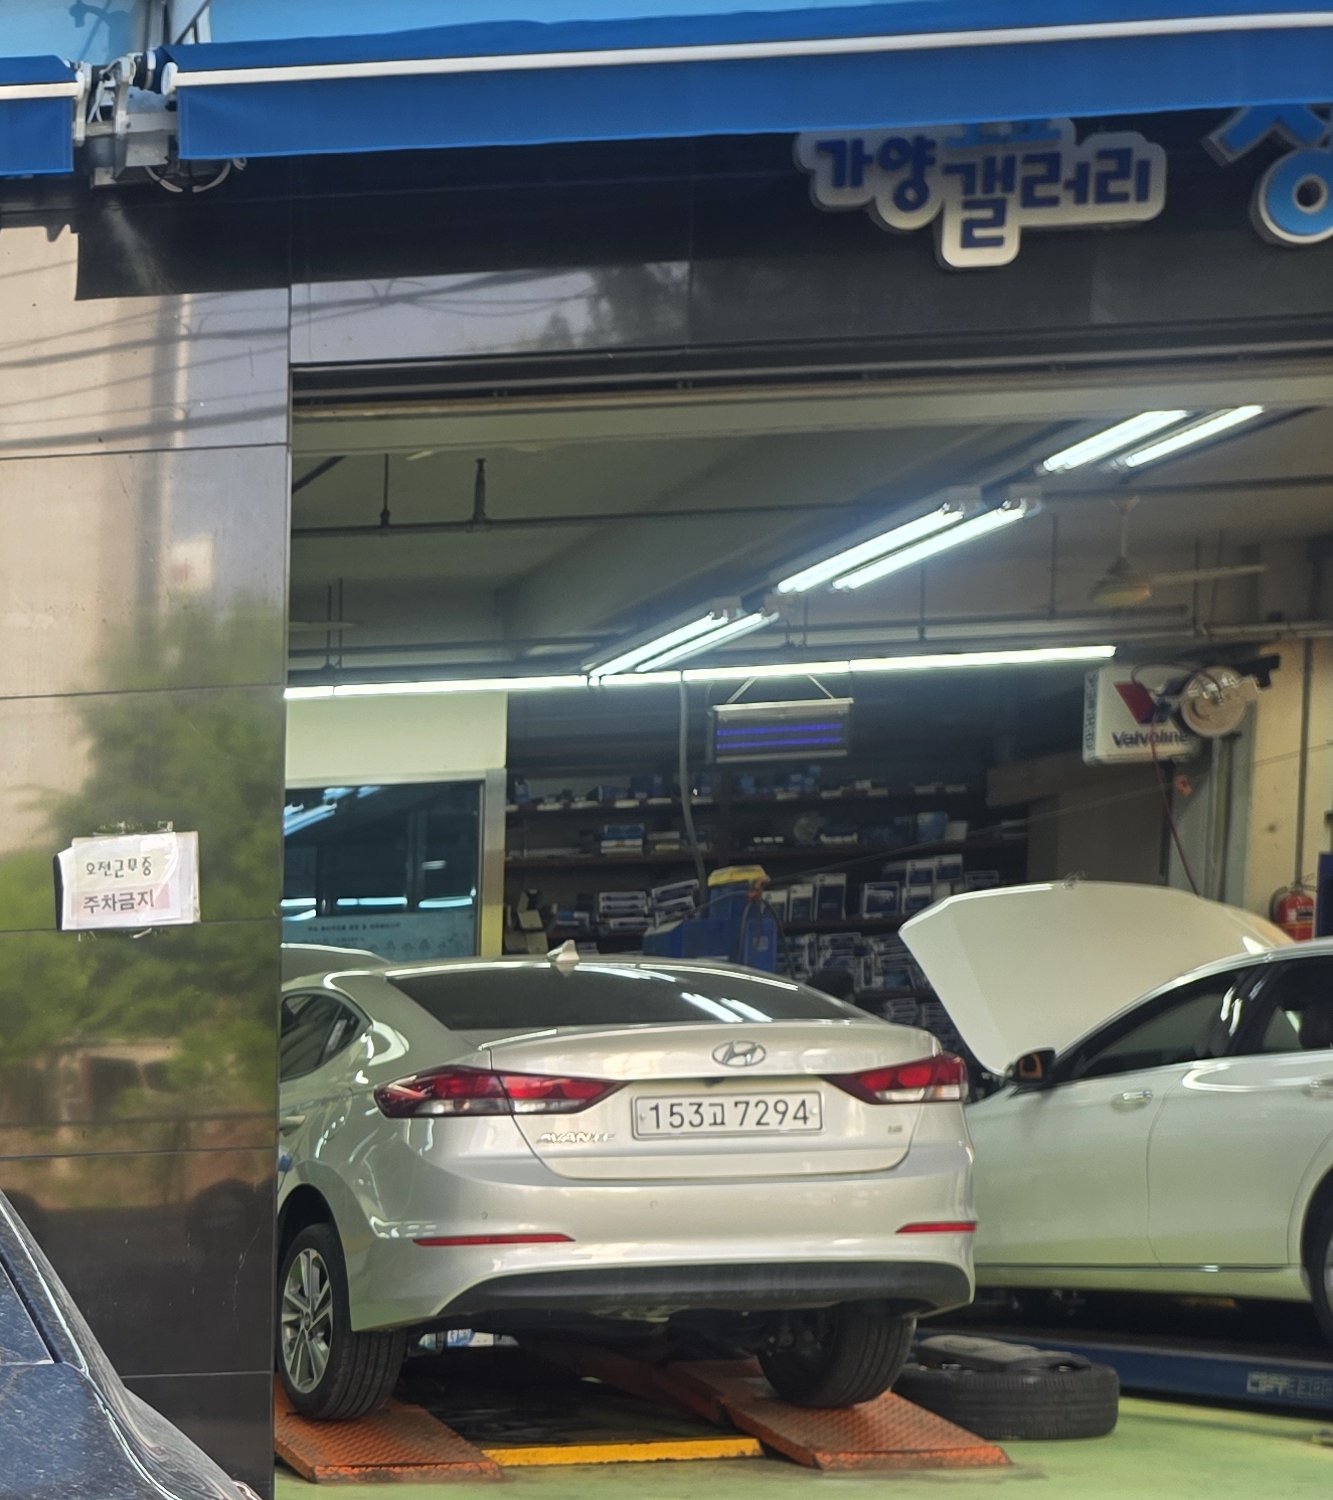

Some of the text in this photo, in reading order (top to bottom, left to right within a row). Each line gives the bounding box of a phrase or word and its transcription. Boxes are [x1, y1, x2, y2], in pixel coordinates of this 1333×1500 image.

[83, 889, 155, 914] 주차금지
[733, 1098, 810, 1127] 7294
[536, 1131, 616, 1144] AVANTE
